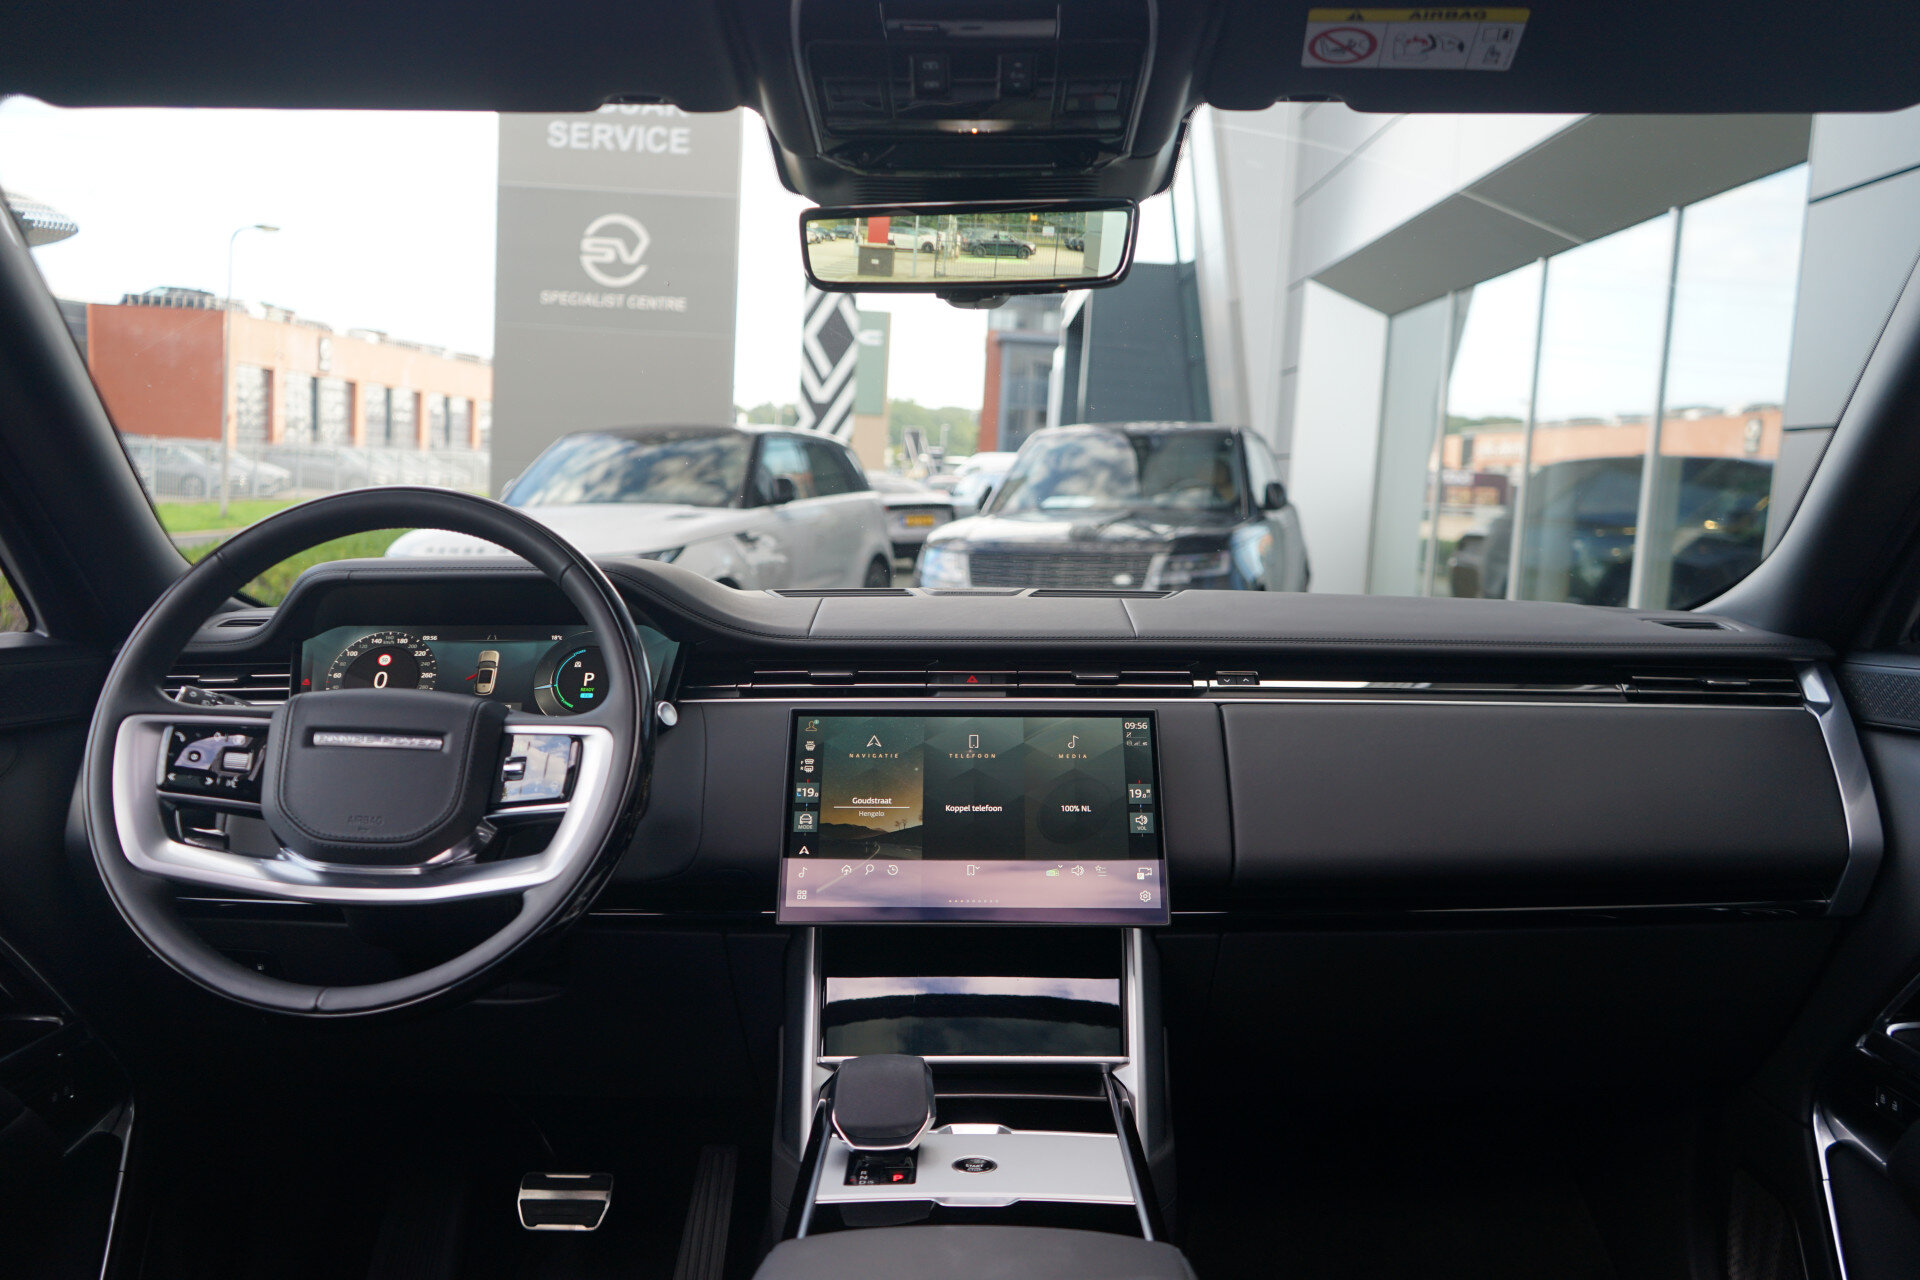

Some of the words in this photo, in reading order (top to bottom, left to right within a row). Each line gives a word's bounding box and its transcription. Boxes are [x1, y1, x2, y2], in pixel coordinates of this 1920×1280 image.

[1409, 10, 1487, 20] AIRBAG
[547, 120, 691, 155] SERVICE
[540, 290, 624, 308] SPECIALIST
[626, 293, 688, 313] CENTRE
[373, 671, 388, 689] 0
[583, 672, 595, 687] P
[1124, 722, 1148, 730] 09:56
[802, 787, 819, 798] 19.0
[1129, 788, 1147, 799] 19.0
[852, 797, 892, 805] Goudstraat
[945, 804, 970, 813] Koppel
[972, 804, 1002, 812] telefoon
[858, 810, 885, 818] Hengelo
[892, 1174, 904, 1182] P
